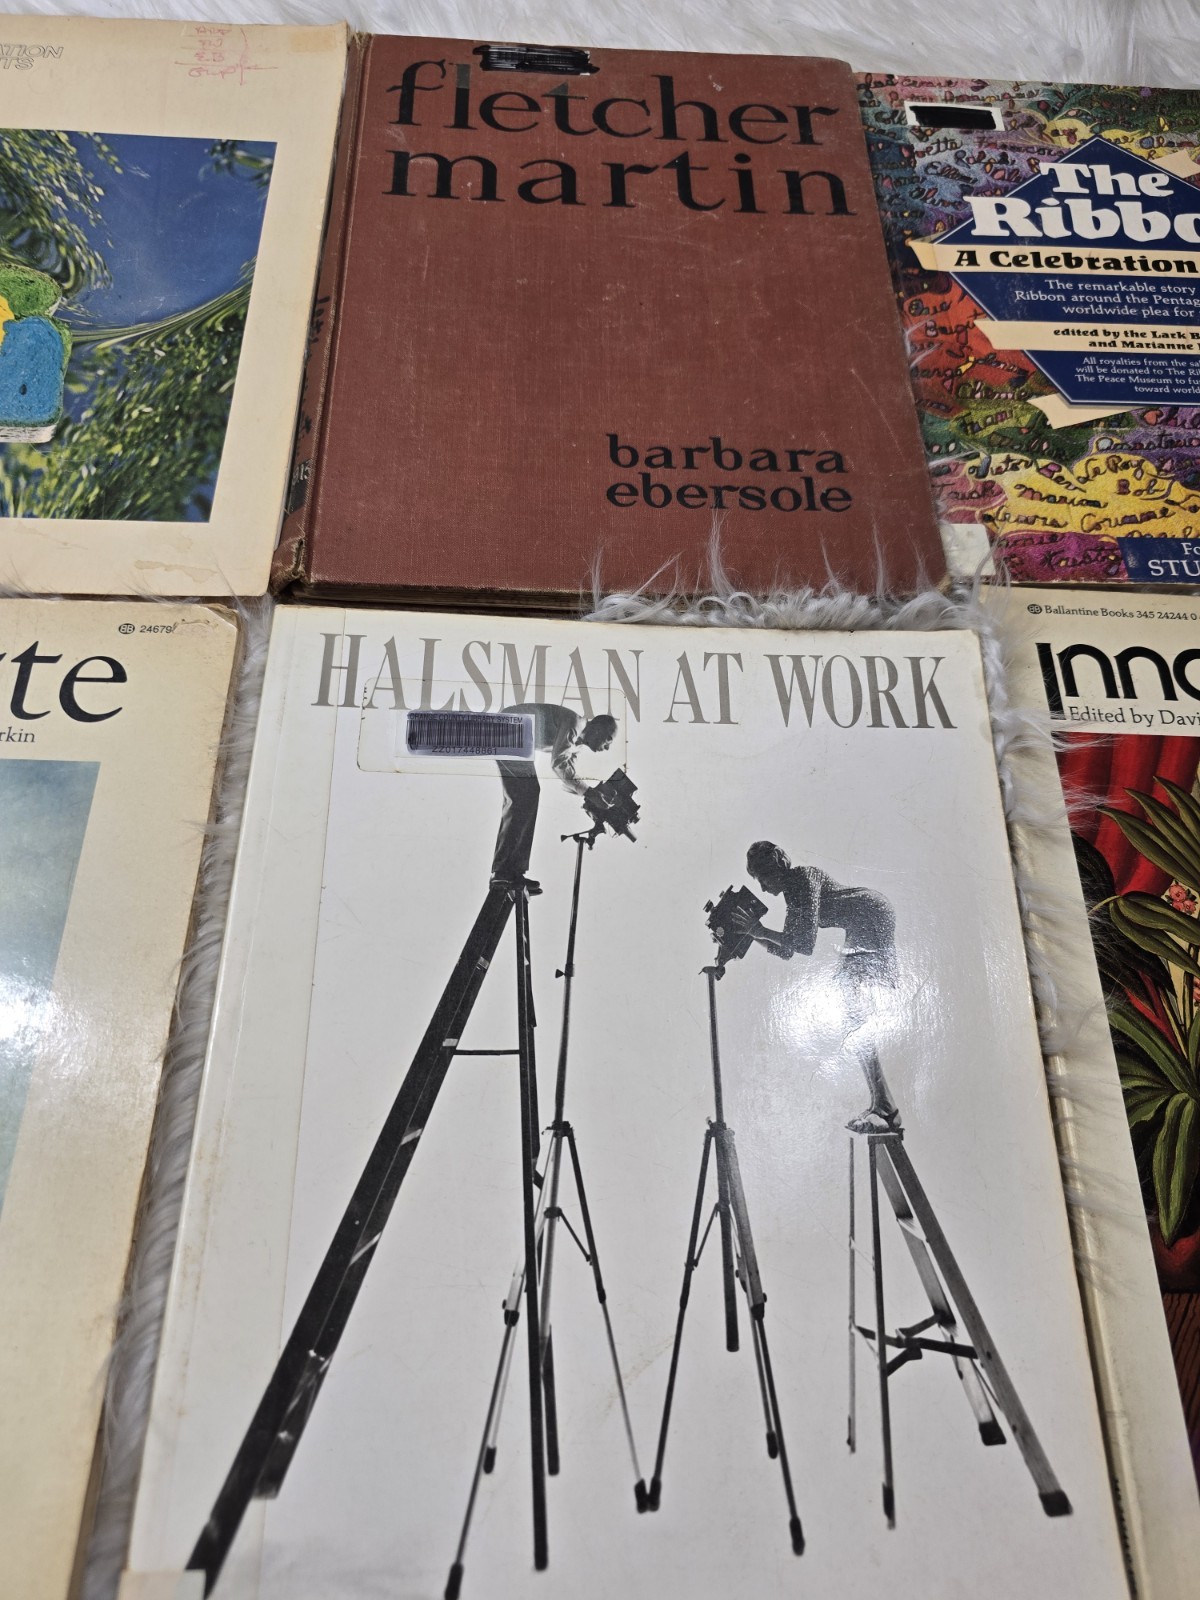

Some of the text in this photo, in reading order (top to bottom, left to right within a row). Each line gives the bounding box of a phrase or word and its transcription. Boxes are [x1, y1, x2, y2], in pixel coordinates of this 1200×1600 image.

[386, 59, 839, 146] fletcher
[381, 150, 857, 216] martin
[1039, 162, 1174, 197] The
[954, 250, 1199, 274] A Celebration
[1044, 279, 1196, 296] The remarkable story
[1014, 290, 1066, 302] Ribbon
[1071, 293, 1122, 304] around
[1126, 294, 1149, 304] the
[1062, 304, 1195, 318] worldwide plea for
[1053, 328, 1099, 337] edited
[1102, 329, 1120, 338] by
[1123, 329, 1147, 338] the
[1150, 330, 1187, 340] Lark
[1088, 340, 1117, 348] and
[1121, 340, 1194, 350] Marianne
[1075, 365, 1094, 374] will
[1096, 365, 1108, 374] be
[1110, 366, 1150, 375] donated
[1152, 367, 1164, 375] to
[1165, 367, 1186, 376] The
[1082, 356, 1097, 365] All
[1099, 357, 1141, 367] royalties
[1143, 358, 1168, 367] from
[1171, 359, 1187, 368] the
[1074, 374, 1096, 383] The
[1098, 374, 1126, 383] Peace
[1128, 375, 1172, 385] Museum
[1174, 377, 1186, 385] to
[1134, 385, 1170, 394] toward
[605, 433, 849, 473] barbara
[606, 471, 852, 513] ebersole
[1148, 559, 1200, 577] STU
[1044, 605, 1099, 617] Ballantine
[1100, 607, 1135, 618] Books
[1136, 610, 1155, 619] 345
[1157, 611, 1188, 620] 24244
[0, 640, 128, 723] te
[311, 632, 958, 729] HALSMAN AT WORK
[496, 715, 523, 724] SYSTEM
[1069, 706, 1126, 724] Edited
[1129, 707, 1154, 727] by
